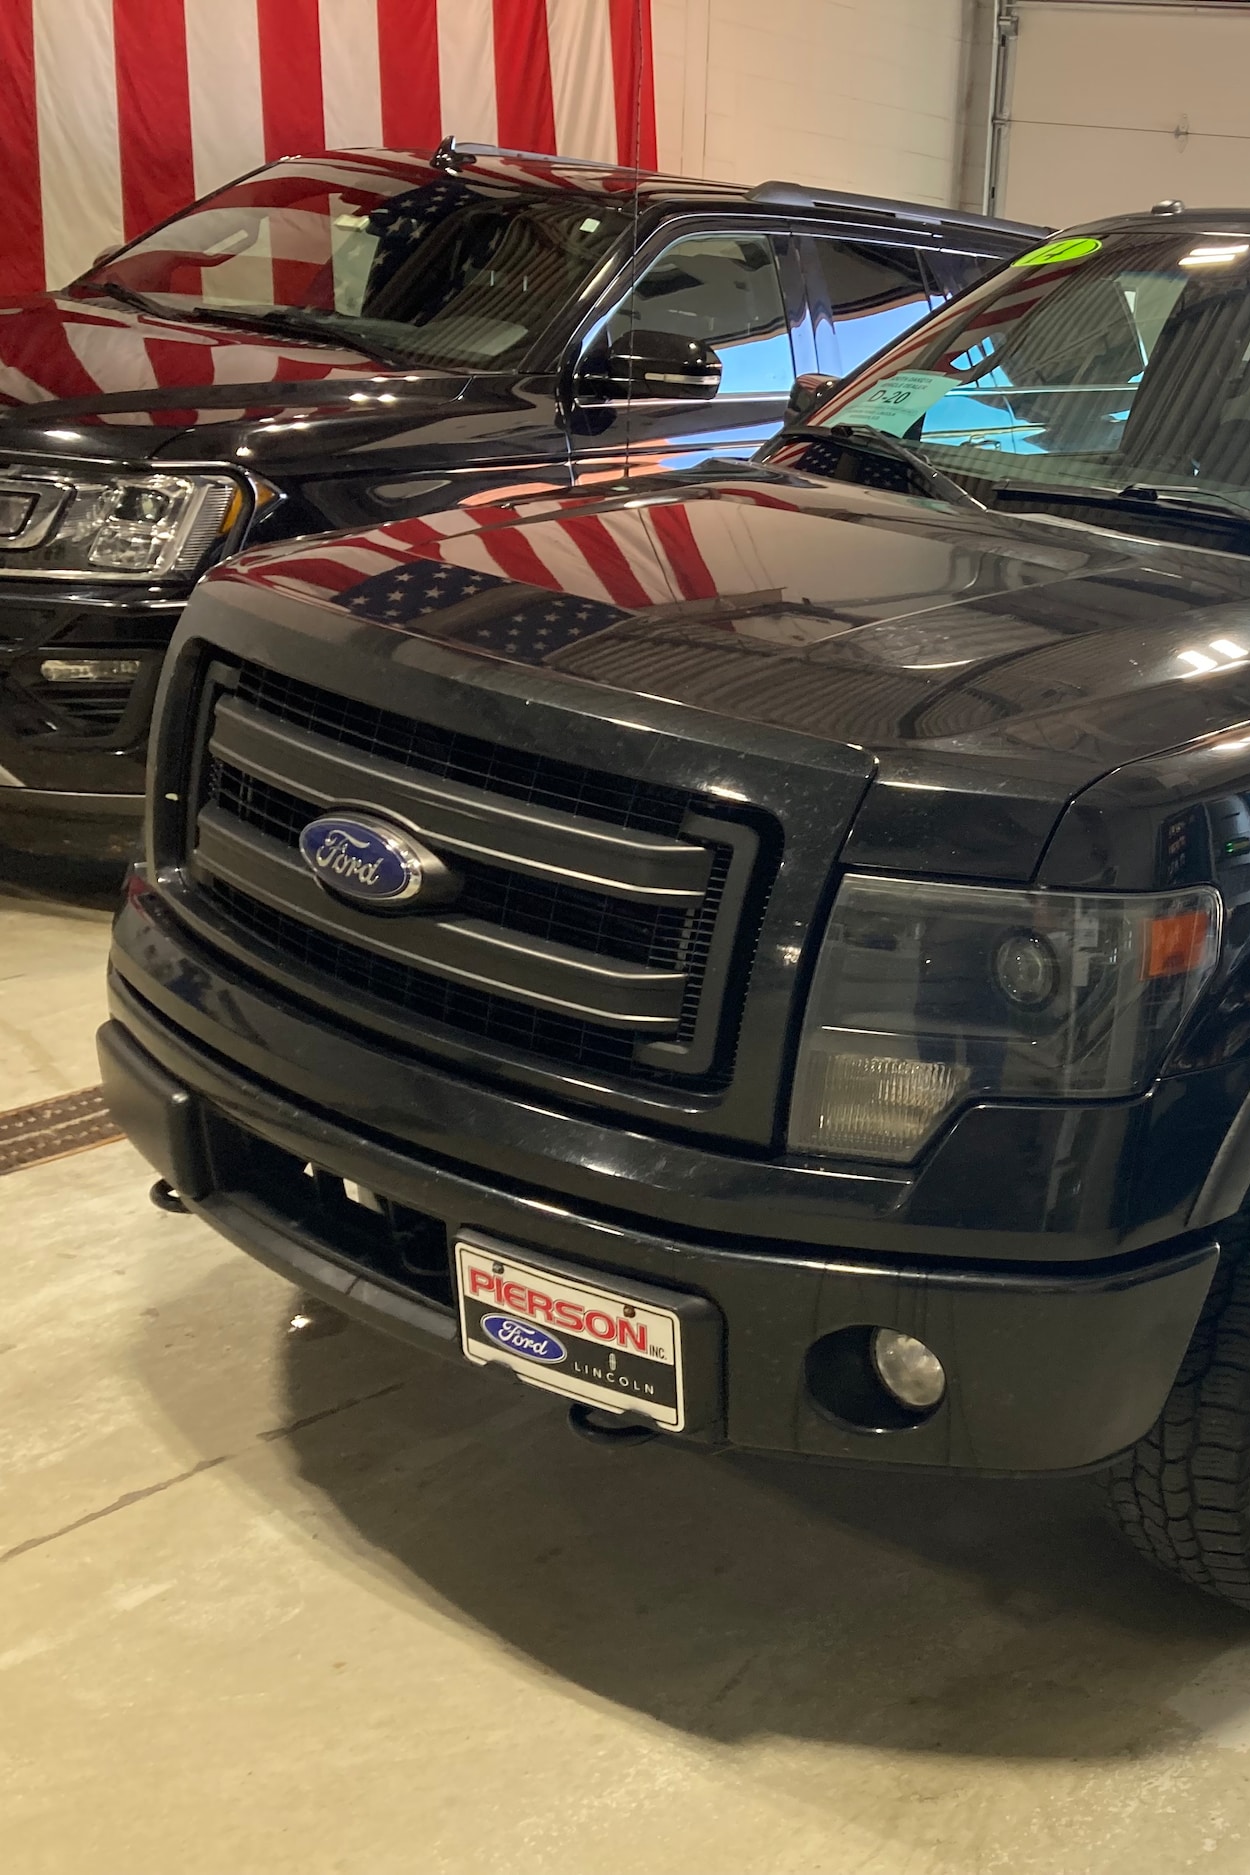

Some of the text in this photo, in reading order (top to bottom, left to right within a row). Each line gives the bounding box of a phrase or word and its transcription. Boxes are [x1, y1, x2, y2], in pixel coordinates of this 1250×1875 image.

[867, 389, 911, 404] D-20
[316, 829, 384, 885] Ford
[467, 1264, 648, 1355] PIERSON
[498, 1320, 548, 1356] Ford
[649, 1343, 668, 1361] INC.
[574, 1361, 655, 1395] LINCOLN
